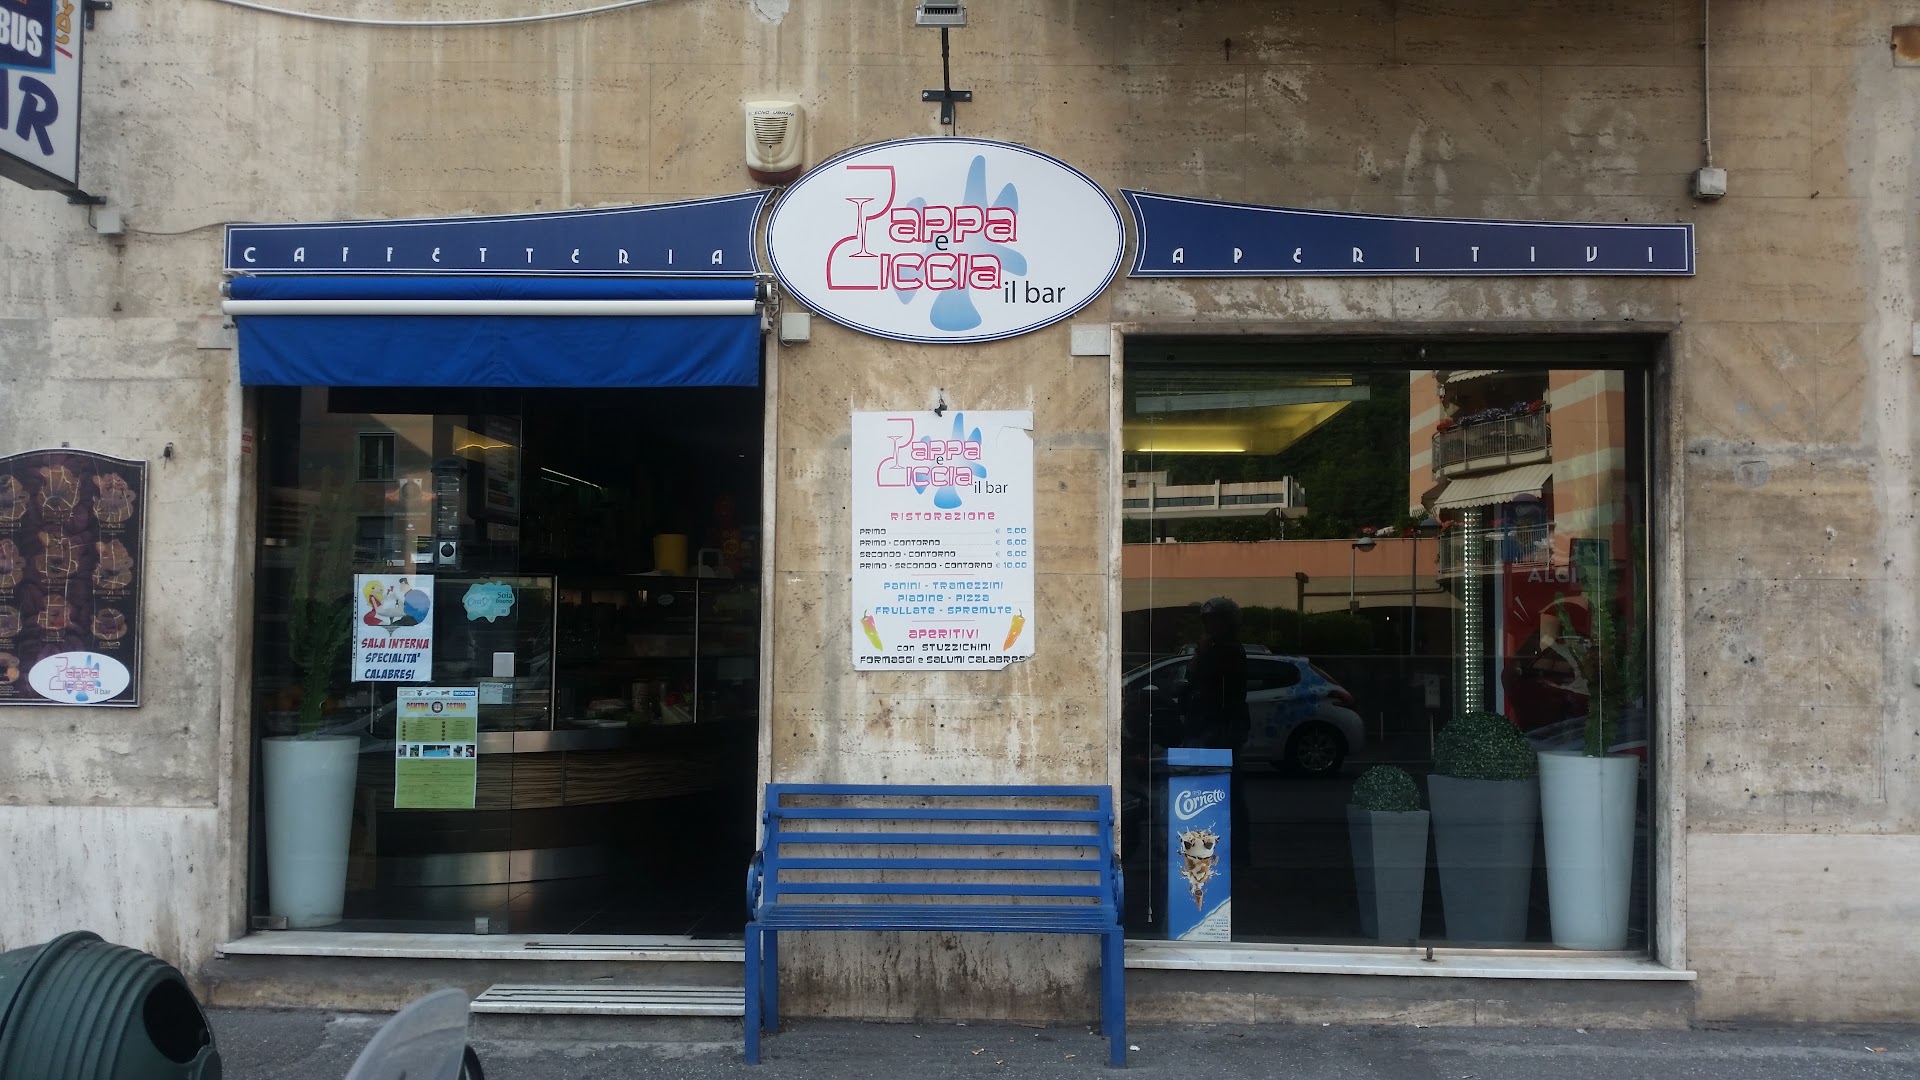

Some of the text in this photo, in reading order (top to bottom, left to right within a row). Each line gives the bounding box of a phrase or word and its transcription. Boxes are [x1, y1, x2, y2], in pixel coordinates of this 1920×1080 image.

[0, 69, 59, 156] R
[935, 235, 949, 251] e
[244, 246, 723, 265] CAFFETTERIA
[1172, 246, 1654, 263] APERITIVI
[1004, 280, 1065, 304] il bar
[936, 456, 944, 465] e
[974, 481, 1008, 494] il bar
[891, 512, 995, 520] RISTORAZIONE
[884, 582, 920, 590] PANINI
[898, 594, 989, 602] PIADINE PIZZA
[876, 606, 1012, 614] FRULLATE SPREMUTE
[909, 629, 979, 639] APERITIVI
[361, 638, 429, 649] SALA INTERNA
[860, 656, 915, 664] FORMAGGI
[365, 669, 414, 679] CALABRESI
[1175, 790, 1226, 820] Cornetto
